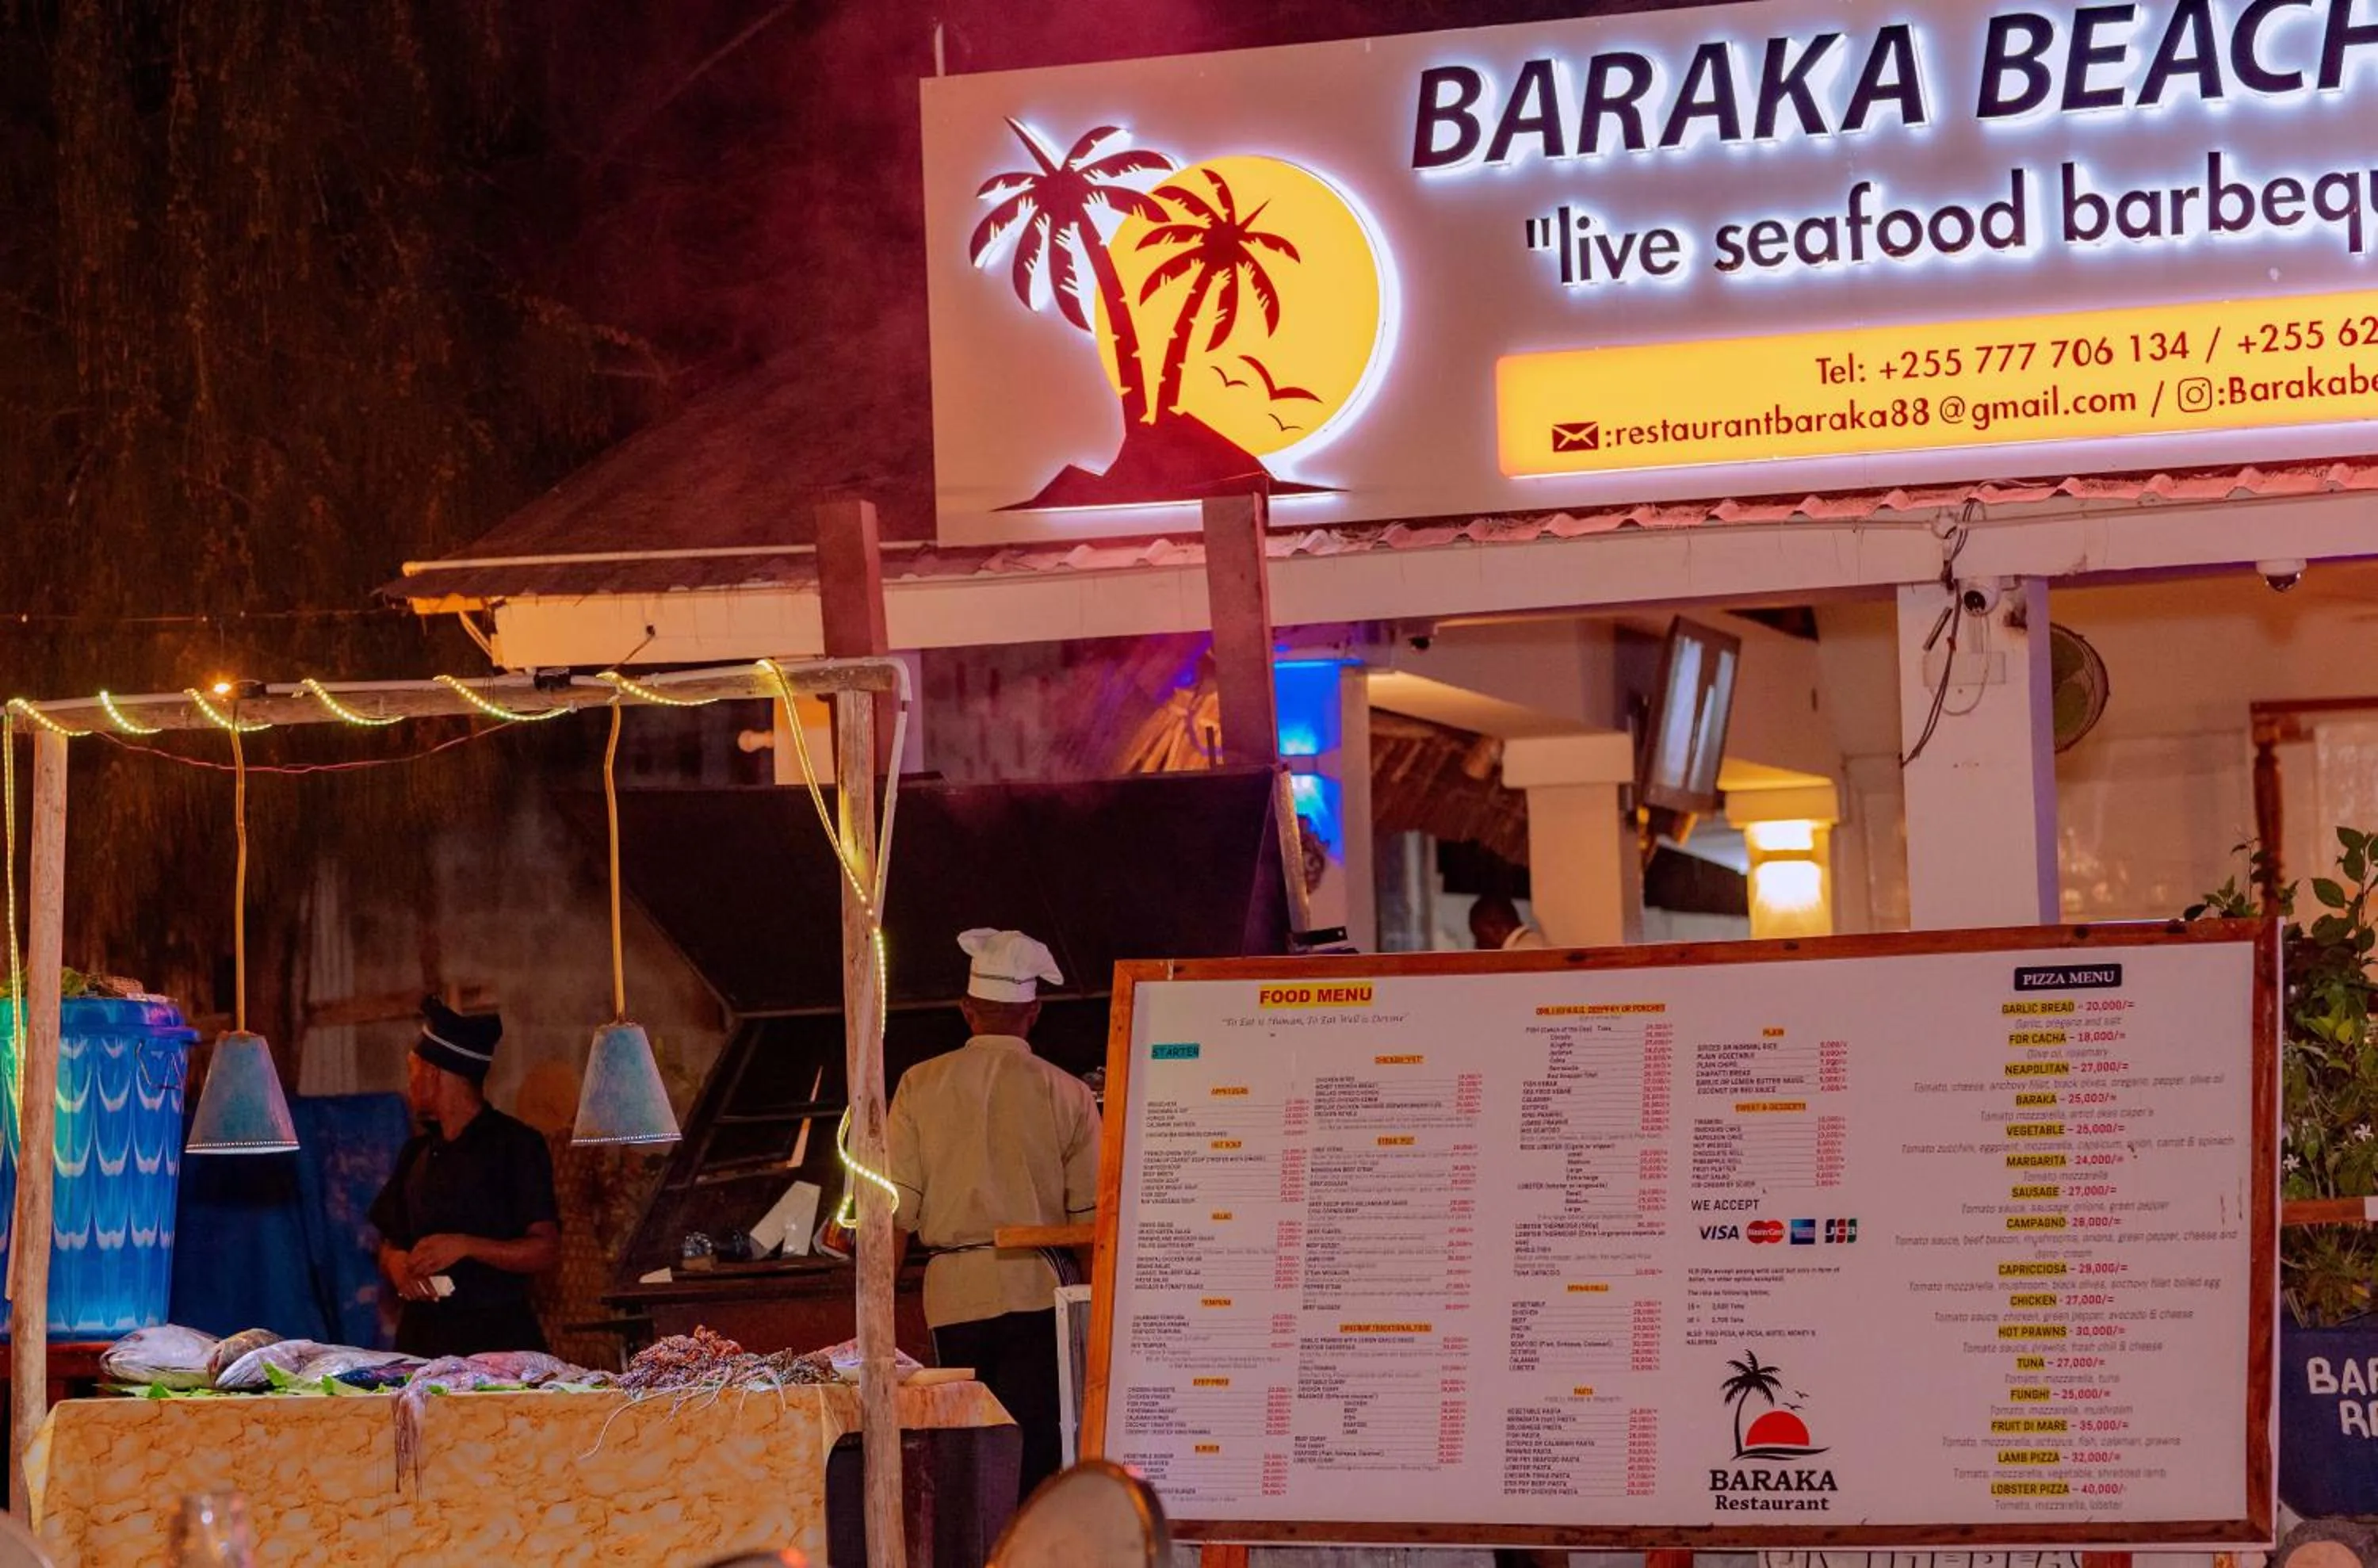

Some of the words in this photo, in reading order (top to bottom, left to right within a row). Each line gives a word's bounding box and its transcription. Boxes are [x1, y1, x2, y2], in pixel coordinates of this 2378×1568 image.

[1412, 25, 1928, 170] BARAKA
[1525, 206, 1680, 285] "live
[1714, 168, 2026, 272] seafood
[2063, 151, 2378, 253] barbeq
[1816, 353, 1866, 384] Tel:
[1879, 349, 1962, 380] +255
[1975, 342, 2036, 373] 777
[2051, 337, 2113, 368] 706
[2130, 331, 2189, 362] 134
[2238, 321, 2324, 354] +255
[2023, 973, 2066, 985] PIZZA
[2069, 970, 2115, 984] MENU
[1259, 989, 1310, 1004] FOOD
[1317, 987, 1373, 1003] MENU
[2001, 1003, 2039, 1014] GARLIC
[2041, 1002, 2074, 1012] BREAD
[2009, 1034, 2029, 1045] FOR
[2032, 1033, 2067, 1044] CACHA
[1152, 1046, 1199, 1058] STARTER
[2004, 1064, 2070, 1076] NEAPOLITAN
[2016, 1095, 2057, 1106] BARAKA
[2006, 1124, 2065, 1136] VEGETABLE
[2006, 1155, 2066, 1167] MARGARITA
[2012, 1187, 2060, 1198] SAUSAGE
[1691, 1199, 1711, 1211] WE
[1714, 1199, 1760, 1210] ACCEPT
[2006, 1218, 2066, 1229] CAMPAGNO
[1699, 1226, 1740, 1240] VISA
[1998, 1264, 2067, 1275] CAPRICCIOSA
[2010, 1295, 2057, 1306] CHICKEN
[1998, 1325, 2019, 1337] HOT
[2021, 1325, 2066, 1337] PRAWNS
[2017, 1358, 2044, 1367] TUNA
[2010, 1389, 2051, 1400] FUNGHI
[1991, 1421, 2021, 1431] FRUIT
[2024, 1421, 2034, 1431] DI
[2036, 1420, 2067, 1431] MARE
[1998, 1452, 2028, 1463] LAMB
[2031, 1451, 2060, 1463] PIZZA
[1709, 1470, 1839, 1491] BARAKA
[1991, 1483, 2036, 1494] LOBSTER
[2040, 1483, 2070, 1494] PIZZA
[1715, 1494, 1830, 1510] Restaurant
